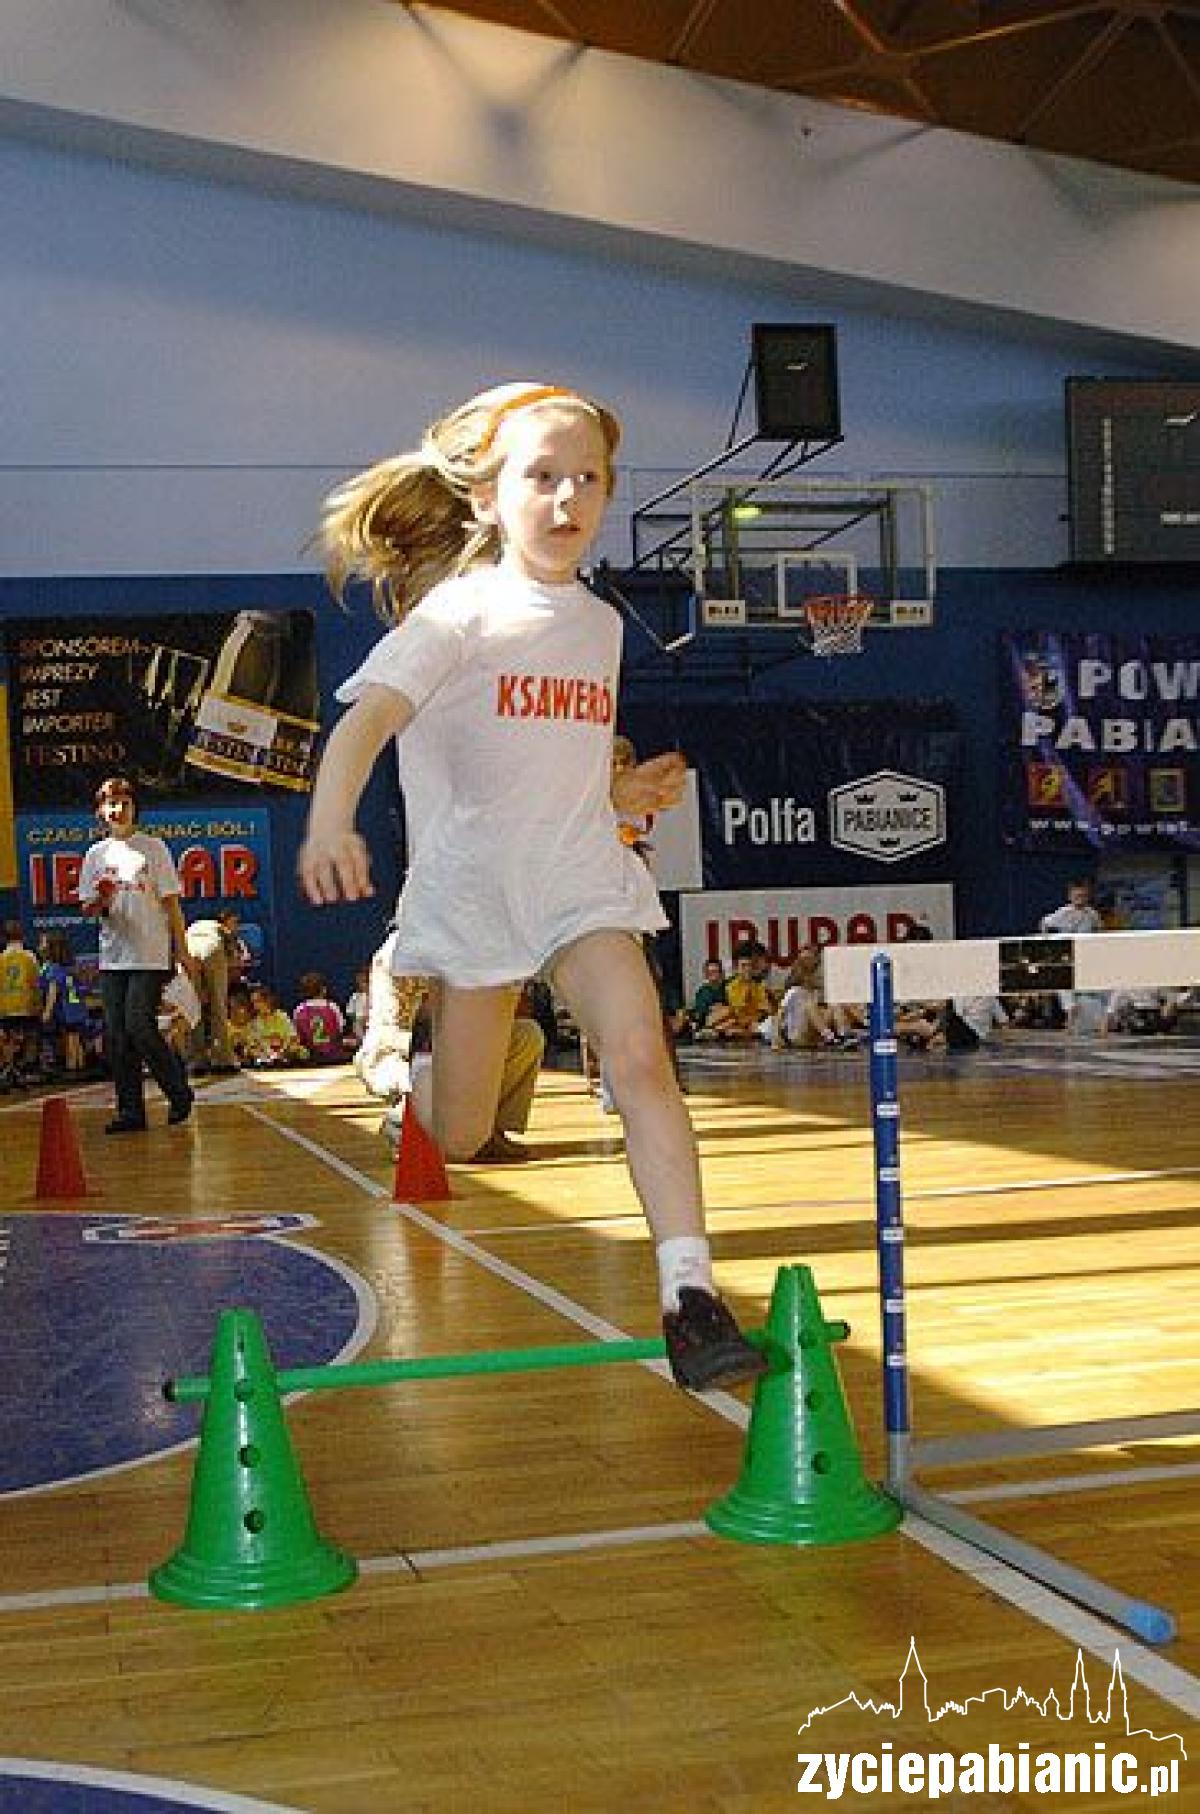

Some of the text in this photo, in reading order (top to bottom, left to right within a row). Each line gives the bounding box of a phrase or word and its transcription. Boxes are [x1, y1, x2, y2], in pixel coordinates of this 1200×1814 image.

[1021, 712, 1200, 752] PABIA
[722, 797, 932, 845] Polfa PABIANICE
[30, 844, 259, 904] IBAR
